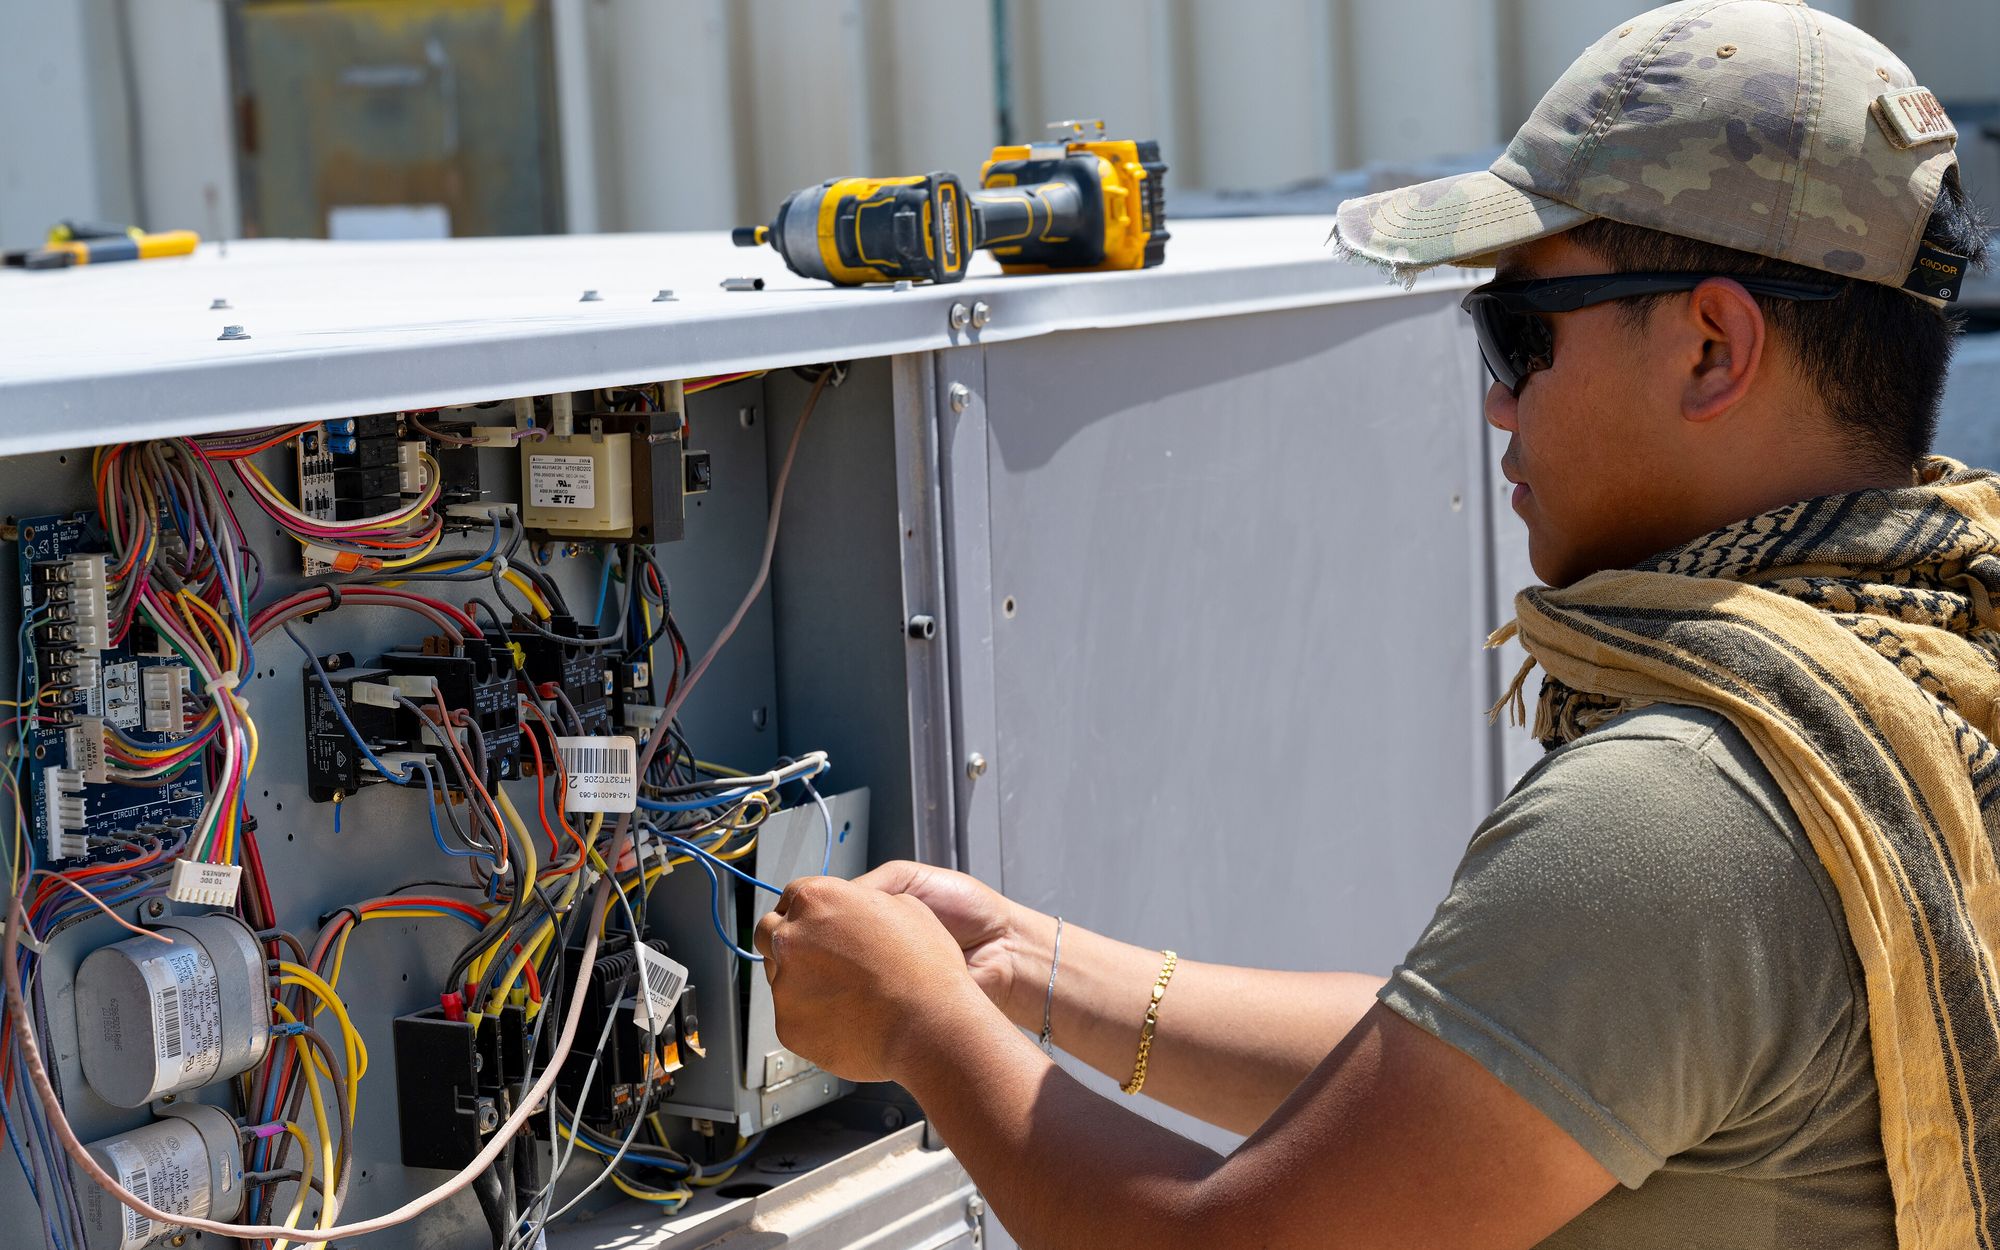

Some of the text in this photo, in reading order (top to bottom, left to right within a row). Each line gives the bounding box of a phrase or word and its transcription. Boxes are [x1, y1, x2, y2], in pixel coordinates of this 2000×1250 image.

[1920, 258, 1957, 274] CONDOR
[564, 495, 576, 504] TE
[25, 573, 30, 582] X
[114, 717, 139, 728] UPANCY
[34, 728, 56, 738] T-STAT
[44, 738, 58, 746] CLASS
[569, 776, 578, 789] 2
[113, 808, 139, 820] CIRCUIT
[96, 820, 108, 829] LPS
[106, 845, 126, 854] CIRC
[187, 954, 198, 973] Castor
[171, 958, 184, 984] E187356
[180, 956, 197, 1000] Characteristic
[156, 992, 166, 1058] HC93CA013D2418
[166, 1157, 174, 1168] Oil
[174, 1164, 182, 1195] 370VAC
[157, 1172, 165, 1212] CA370-10V-
